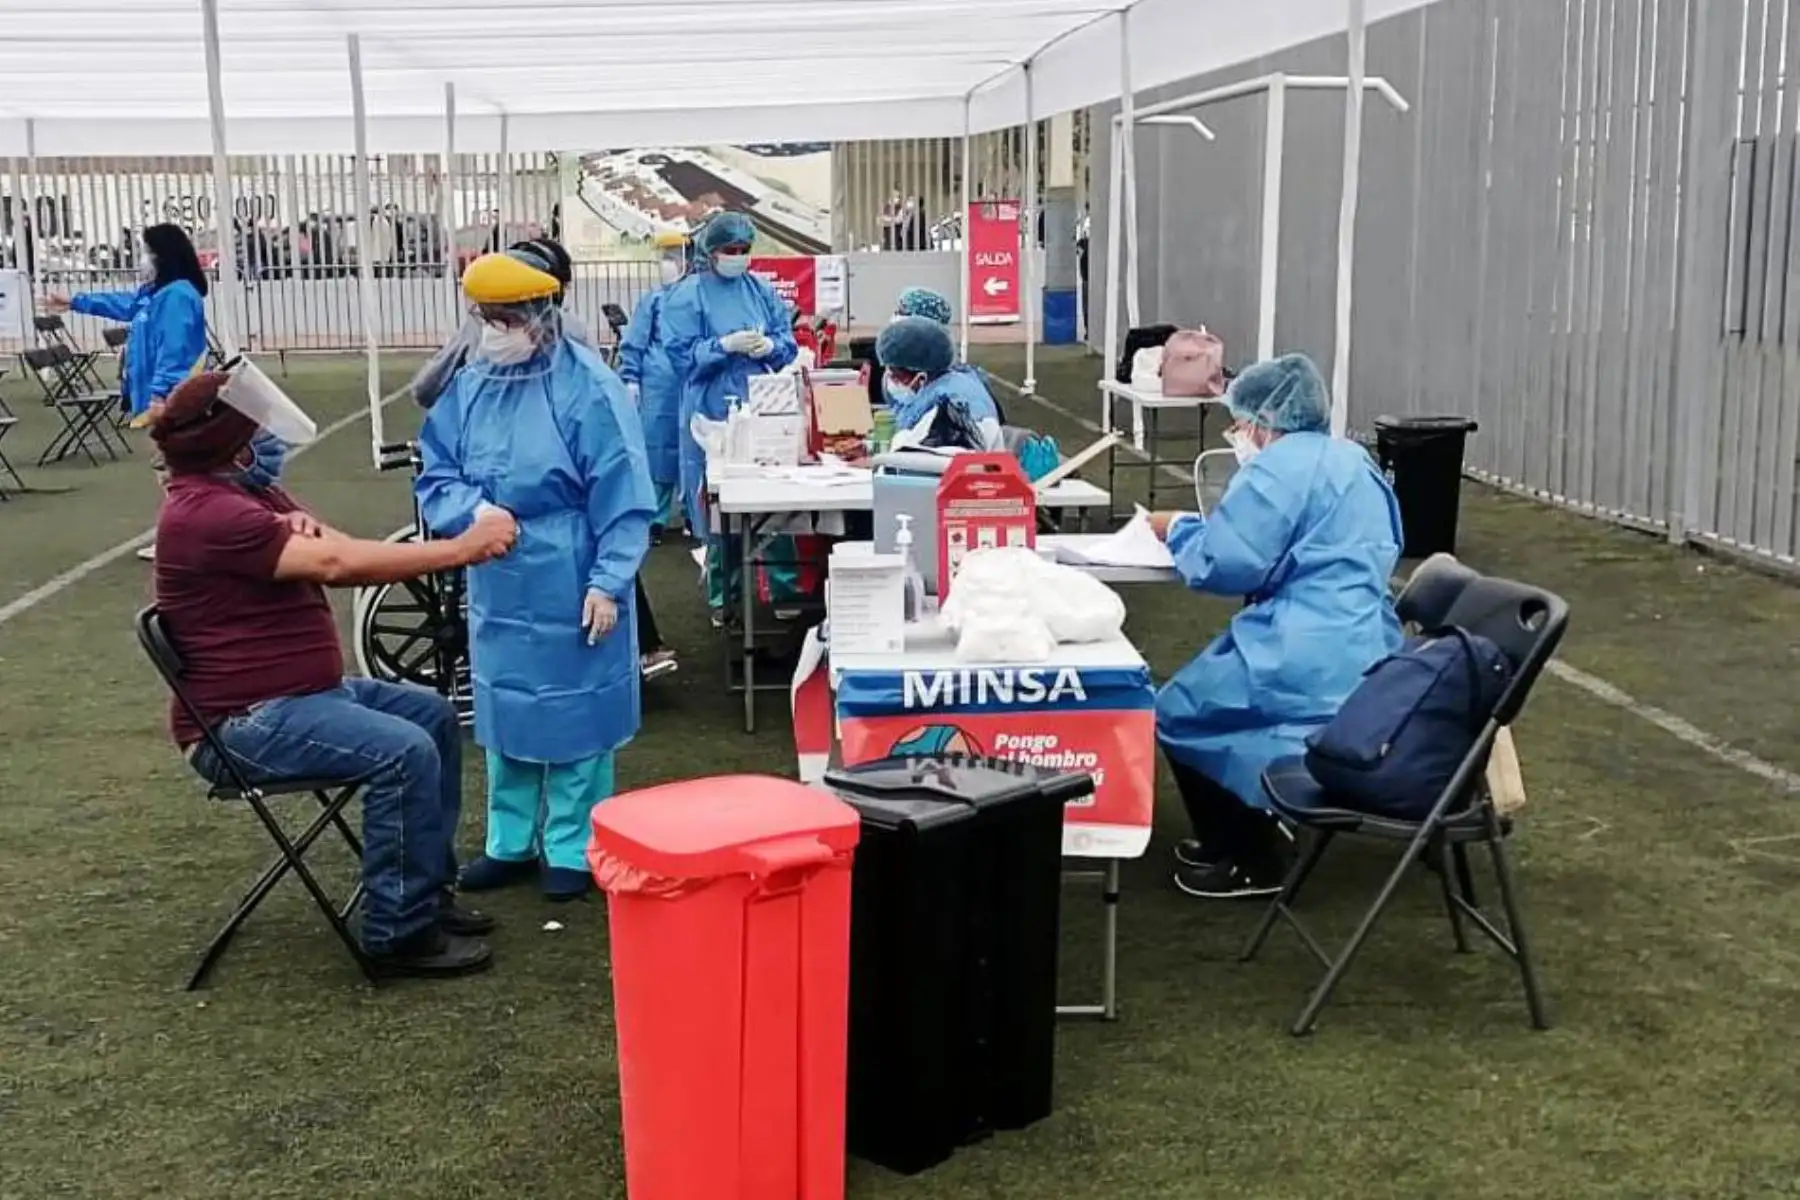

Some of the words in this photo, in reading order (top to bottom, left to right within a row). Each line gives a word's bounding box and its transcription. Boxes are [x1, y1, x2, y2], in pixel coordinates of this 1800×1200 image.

[975, 251, 1013, 266] SALIDA
[903, 667, 1087, 708] MINSA
[995, 733, 1058, 753] Pongo
[1019, 749, 1098, 767] hombro
